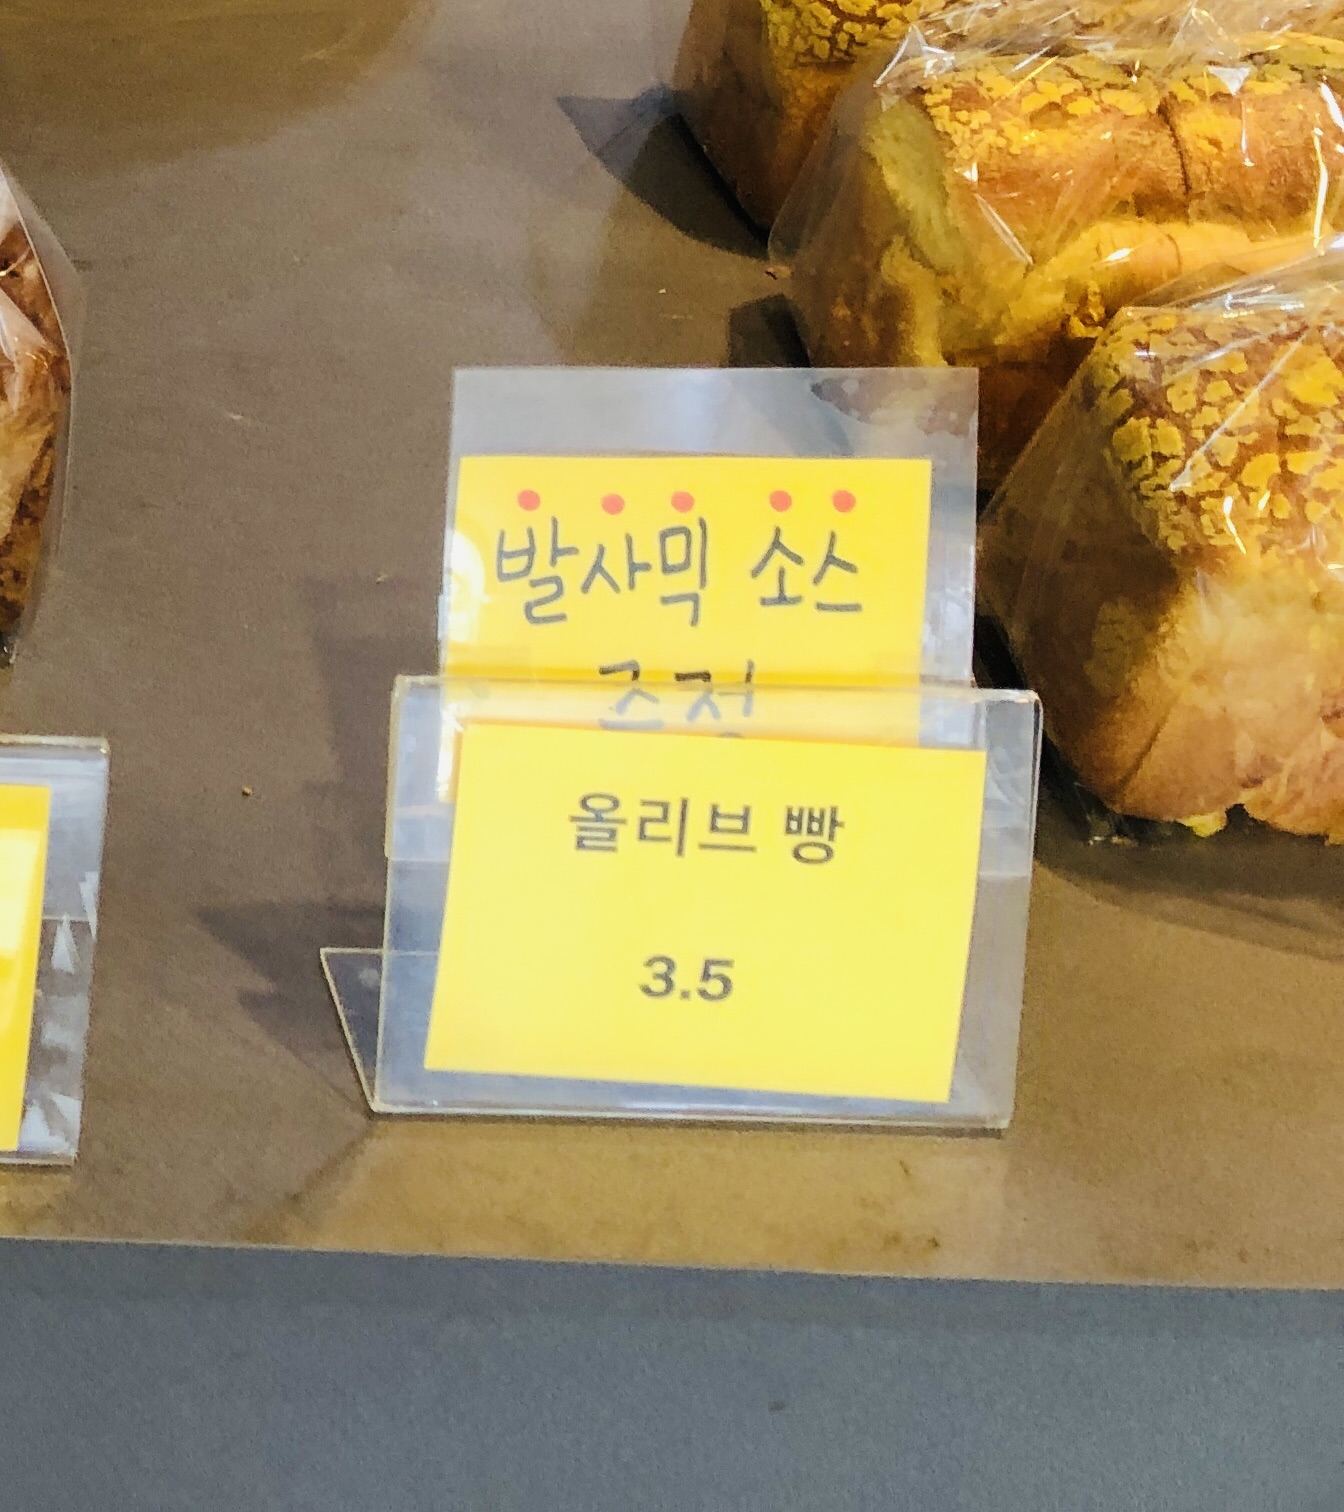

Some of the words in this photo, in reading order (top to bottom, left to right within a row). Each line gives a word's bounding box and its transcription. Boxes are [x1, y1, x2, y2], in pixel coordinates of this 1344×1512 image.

[494, 515, 710, 628] 발사믹
[749, 525, 864, 614] 소스
[569, 792, 758, 857] 올리브
[784, 805, 845, 865] 빵
[639, 954, 735, 1003] 3.5
